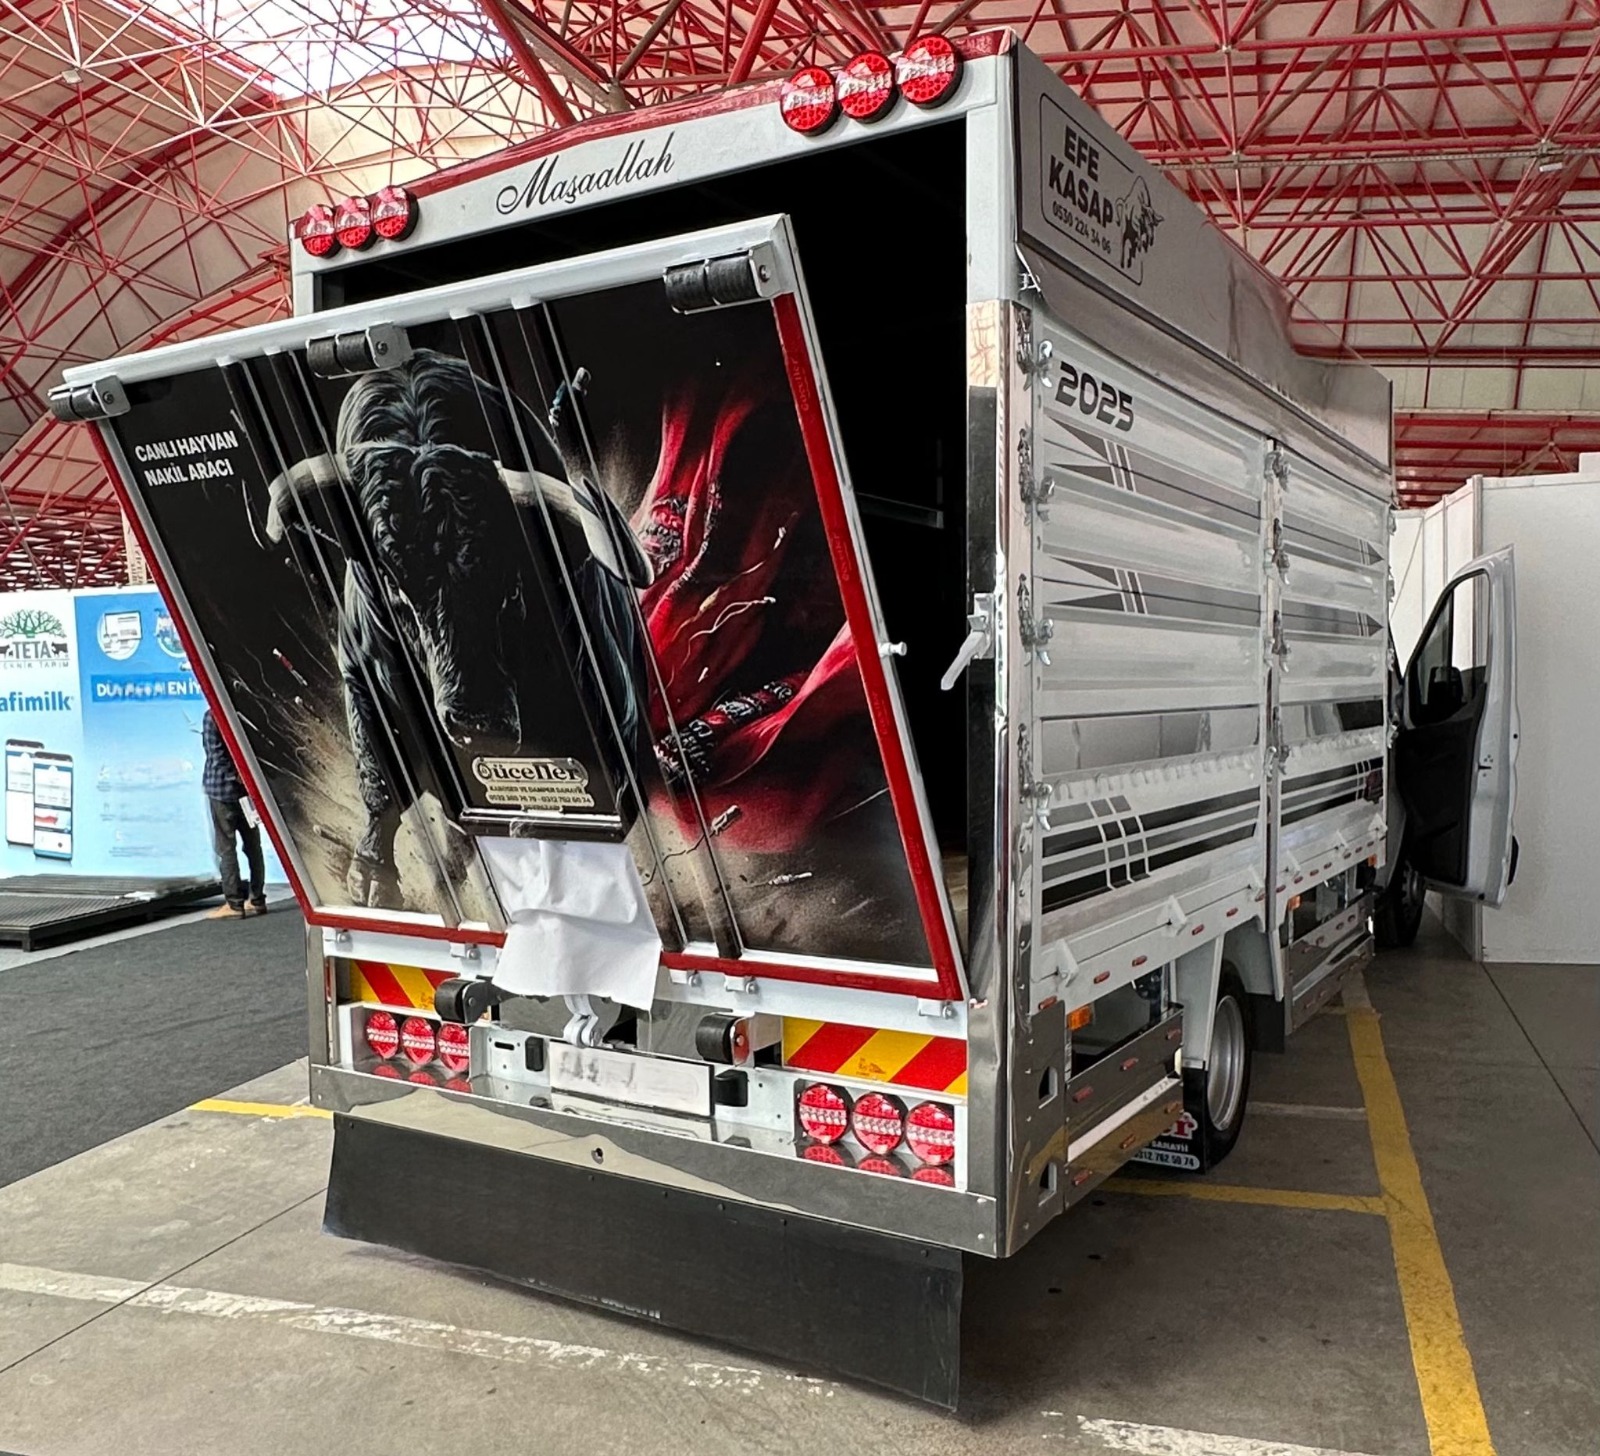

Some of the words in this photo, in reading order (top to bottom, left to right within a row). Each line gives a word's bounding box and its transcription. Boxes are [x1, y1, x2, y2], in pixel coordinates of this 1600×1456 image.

[496, 131, 675, 215] Maşaallah
[1064, 124, 1099, 182] EFE
[1049, 154, 1113, 228] KASAP
[1055, 361, 1134, 432] 2025
[135, 440, 178, 462] CANLI
[176, 430, 239, 456] HAYVAN
[144, 462, 188, 487] NAKİL
[188, 458, 234, 481] ARACI
[12, 641, 51, 660] TETA
[168, 681, 187, 696] EN
